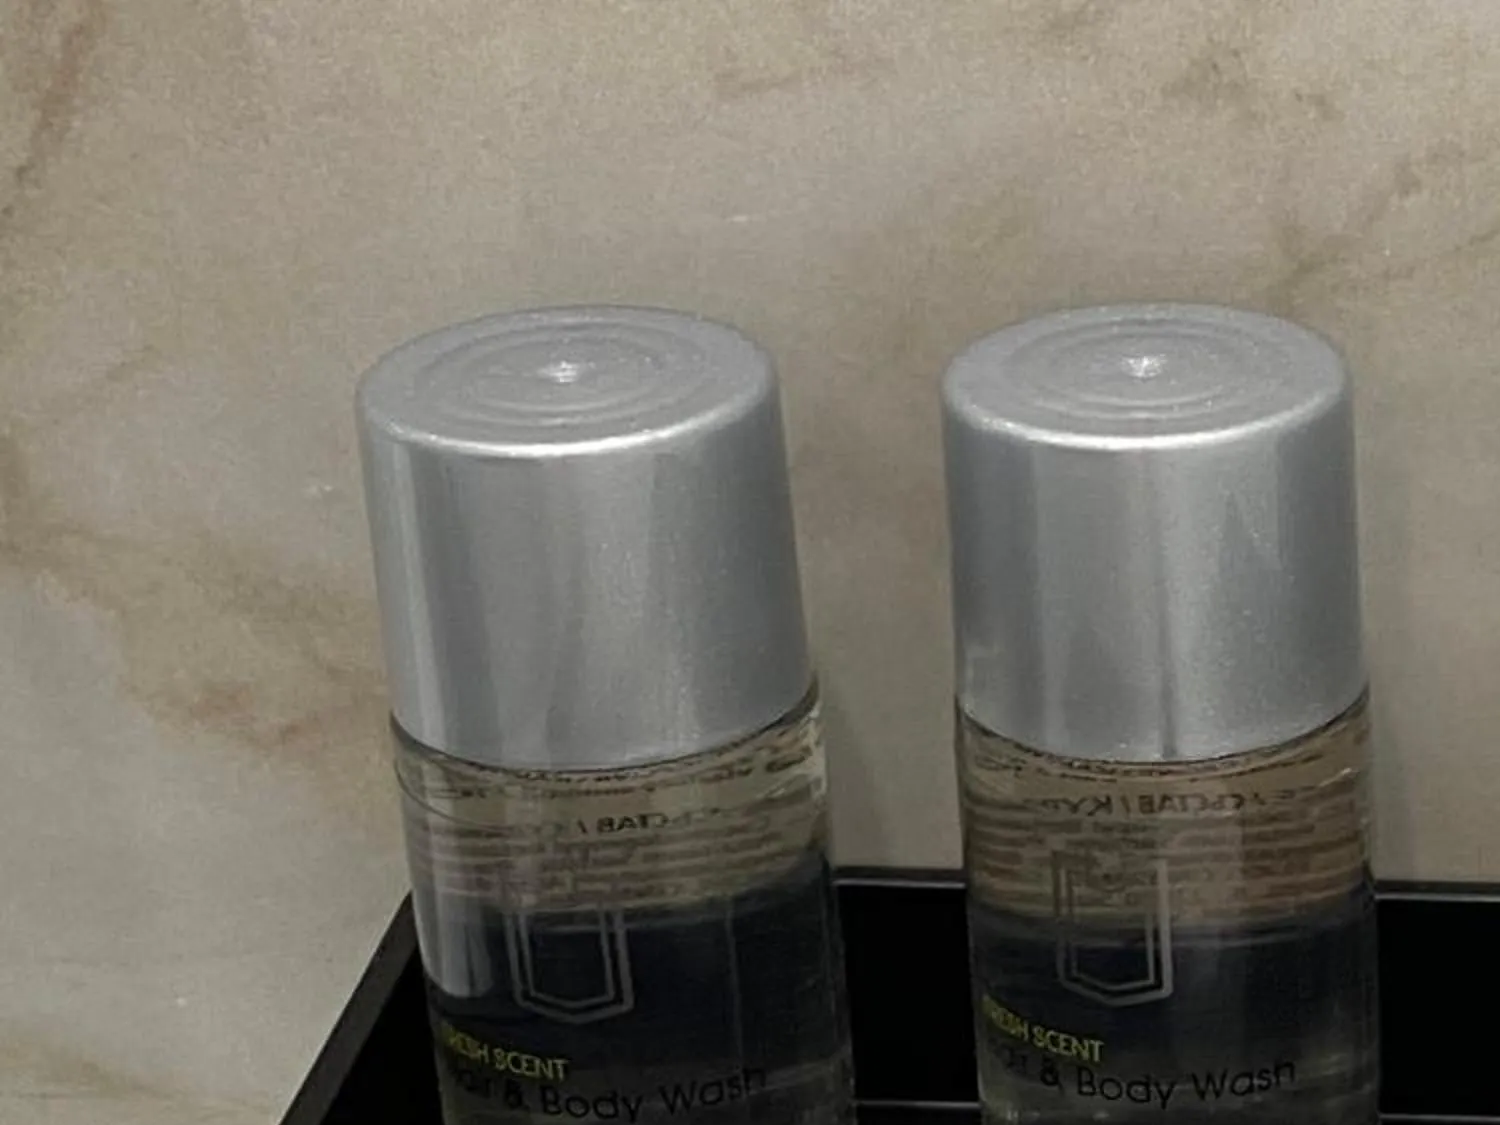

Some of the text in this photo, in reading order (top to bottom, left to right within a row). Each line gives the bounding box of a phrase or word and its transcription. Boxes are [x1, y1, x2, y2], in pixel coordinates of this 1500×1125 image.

[493, 1047, 571, 1083] SCENT
[1032, 1026, 1106, 1064] SCENT
[540, 1084, 644, 1124] Body
[658, 1067, 768, 1116] Wash
[1076, 1065, 1177, 1110] Body
[1191, 1058, 1297, 1100] Wash
